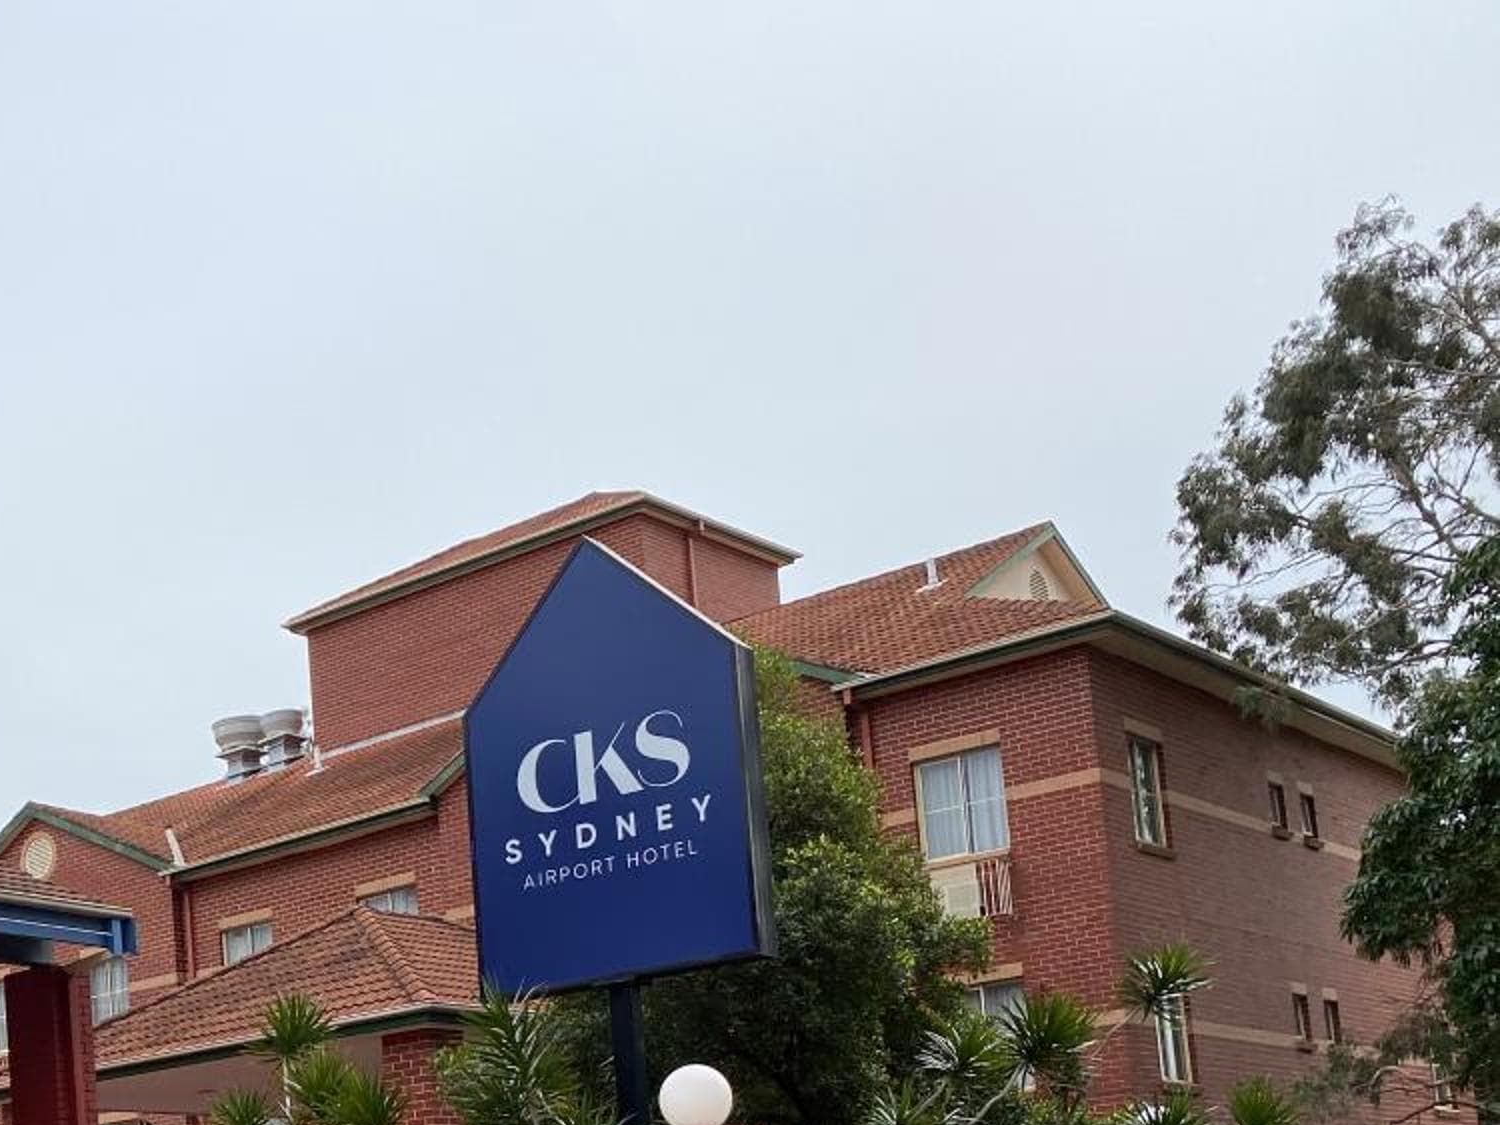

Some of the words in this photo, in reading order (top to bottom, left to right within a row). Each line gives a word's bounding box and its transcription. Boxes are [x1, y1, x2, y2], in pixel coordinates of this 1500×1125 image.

[517, 710, 690, 813] CKS
[505, 794, 711, 865] SYDNEY
[523, 856, 615, 890] AIRPORT
[627, 840, 698, 869] HOTEL
